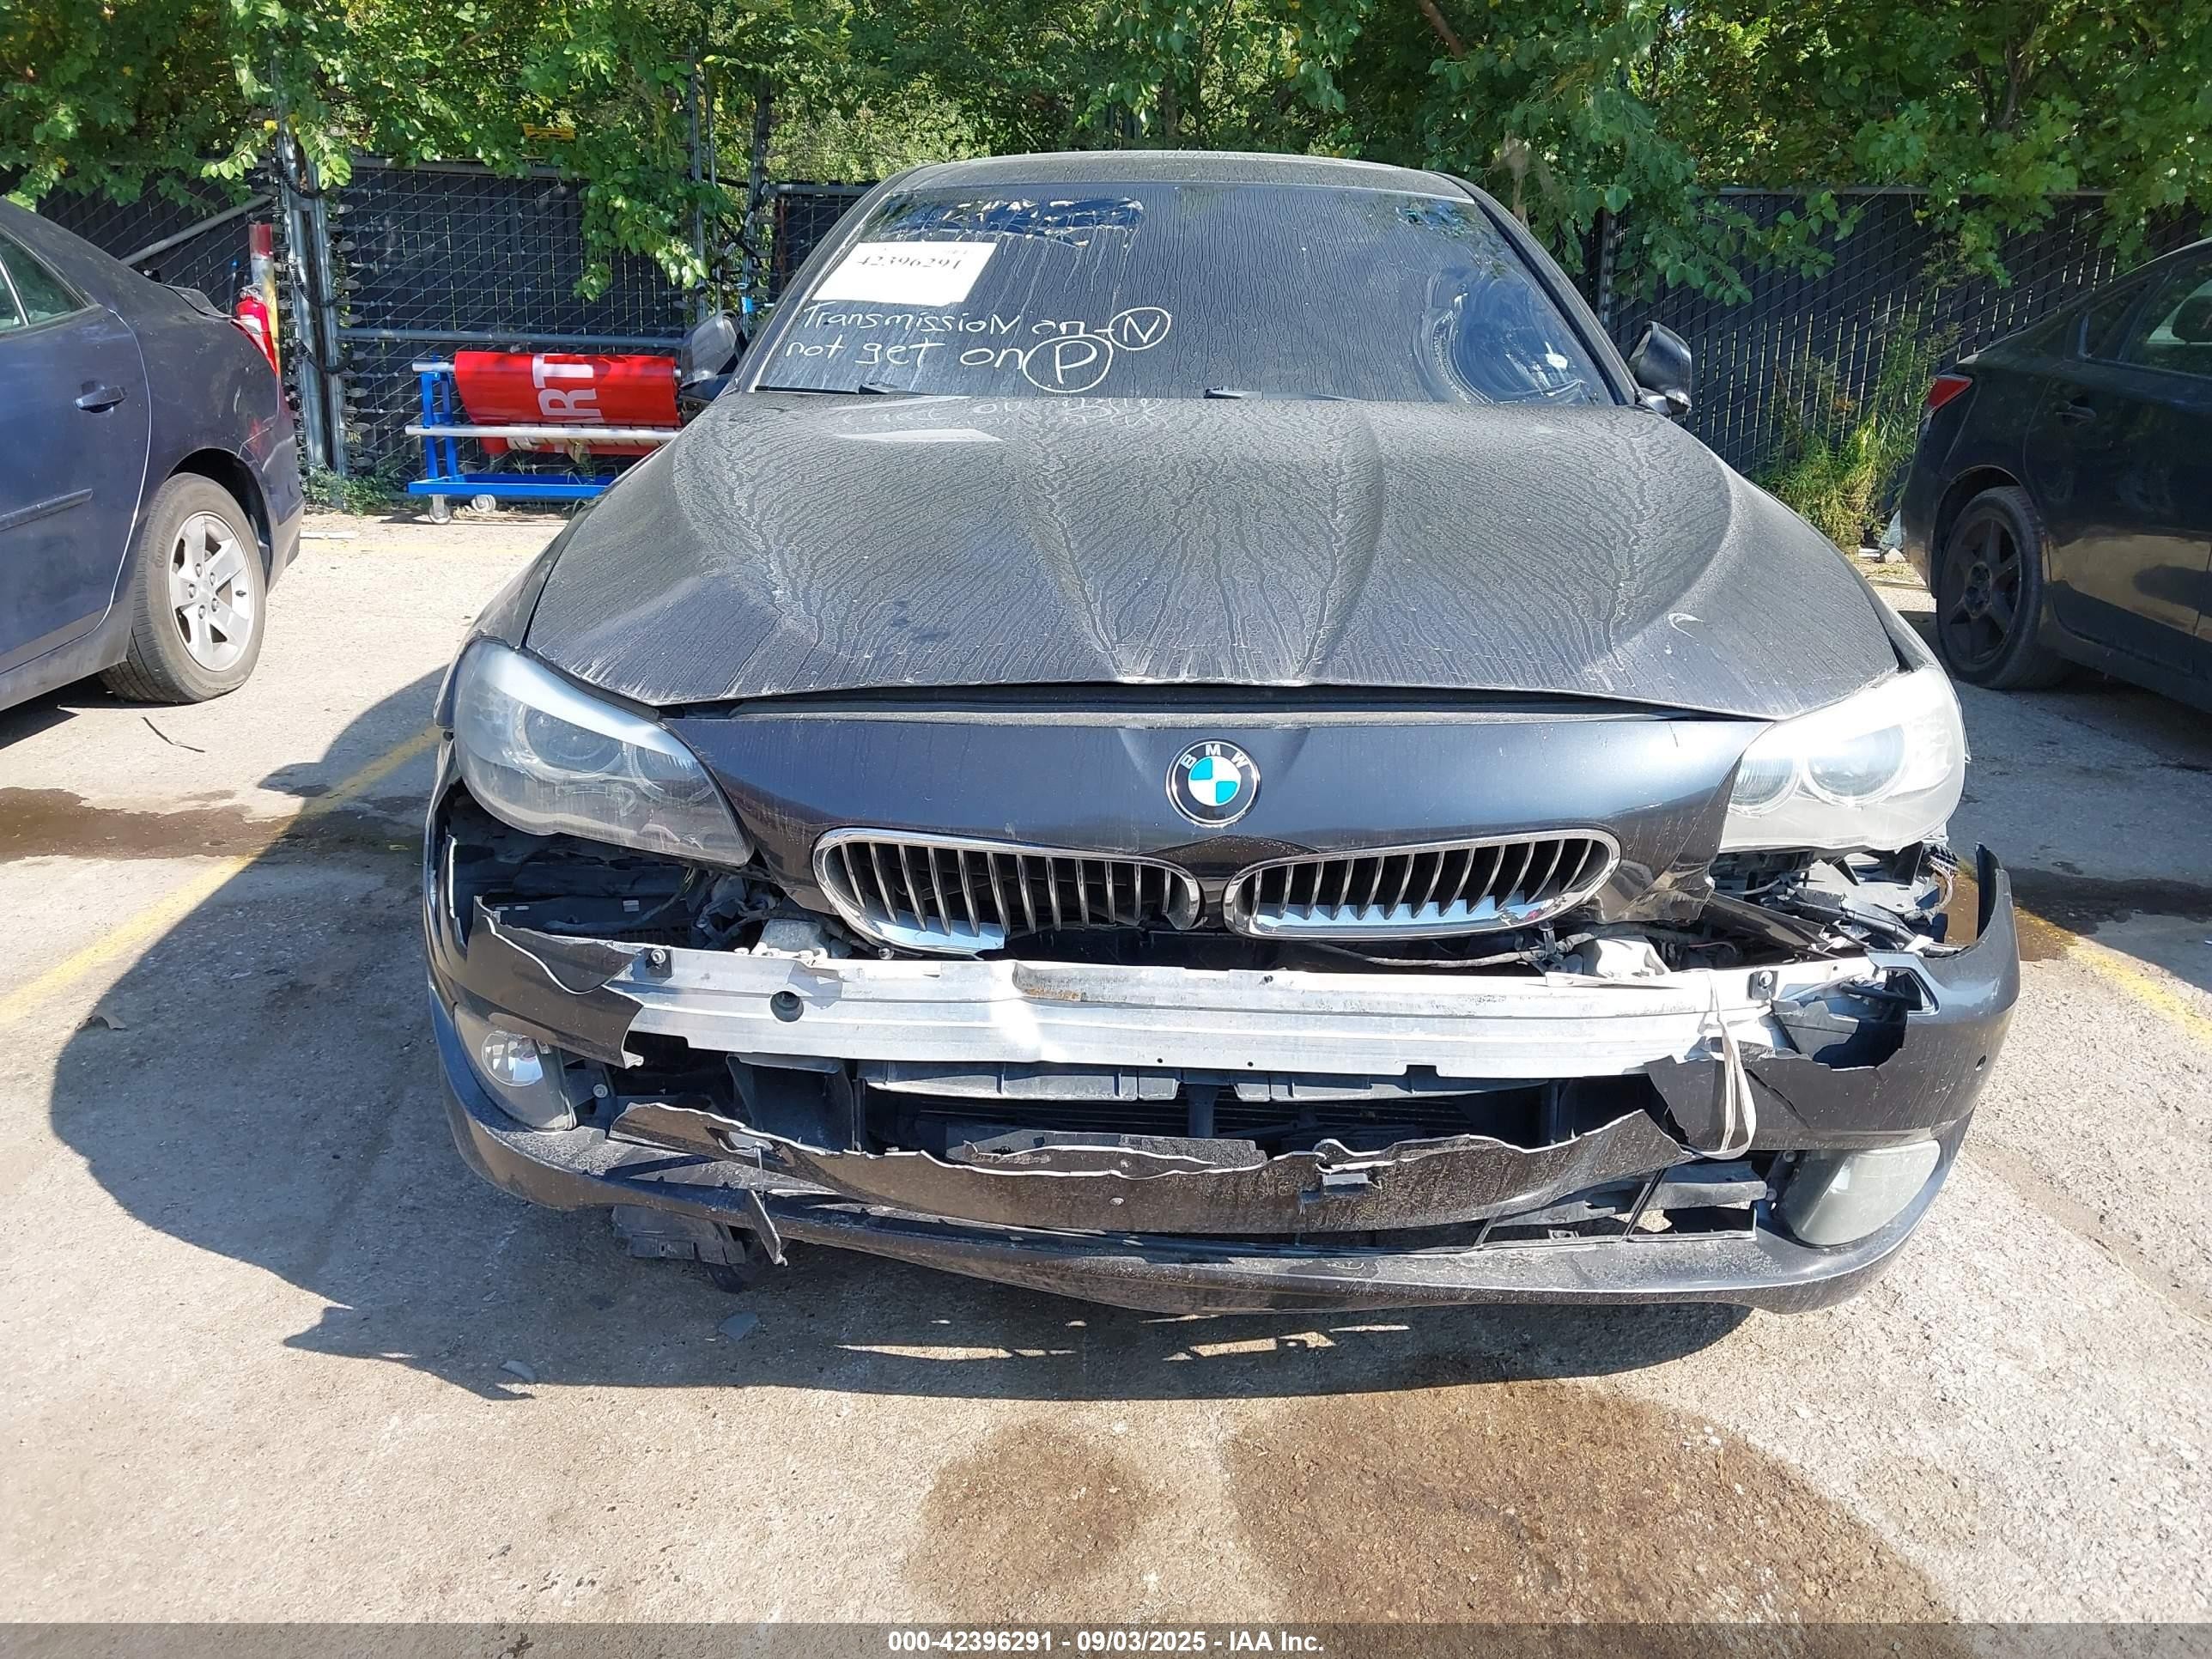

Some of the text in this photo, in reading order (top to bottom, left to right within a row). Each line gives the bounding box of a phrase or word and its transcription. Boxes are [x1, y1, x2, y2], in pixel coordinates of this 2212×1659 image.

[785, 334, 845, 358] not
[854, 337, 946, 368] get
[959, 347, 1024, 370] on
[532, 354, 605, 423] RT
[1180, 743, 1249, 769] BMW
